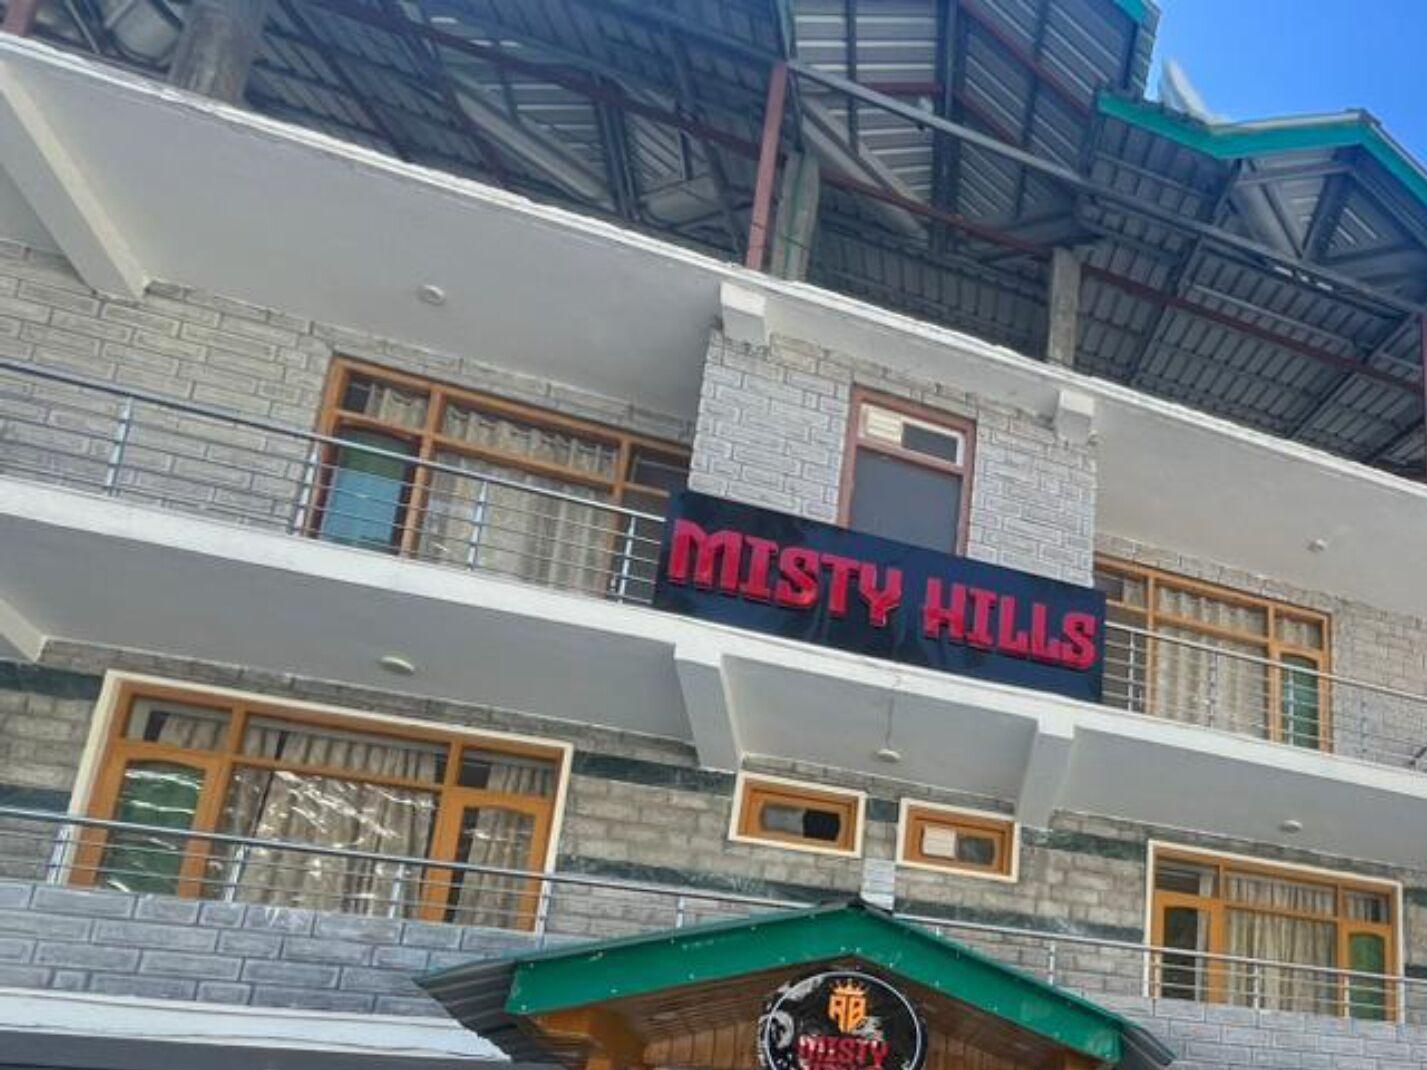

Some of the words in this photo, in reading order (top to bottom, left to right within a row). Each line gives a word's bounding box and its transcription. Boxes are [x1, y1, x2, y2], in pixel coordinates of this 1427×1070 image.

[668, 519, 903, 627] MISTY
[923, 577, 1098, 670] HILLS
[798, 1034, 890, 1068] MISTY
